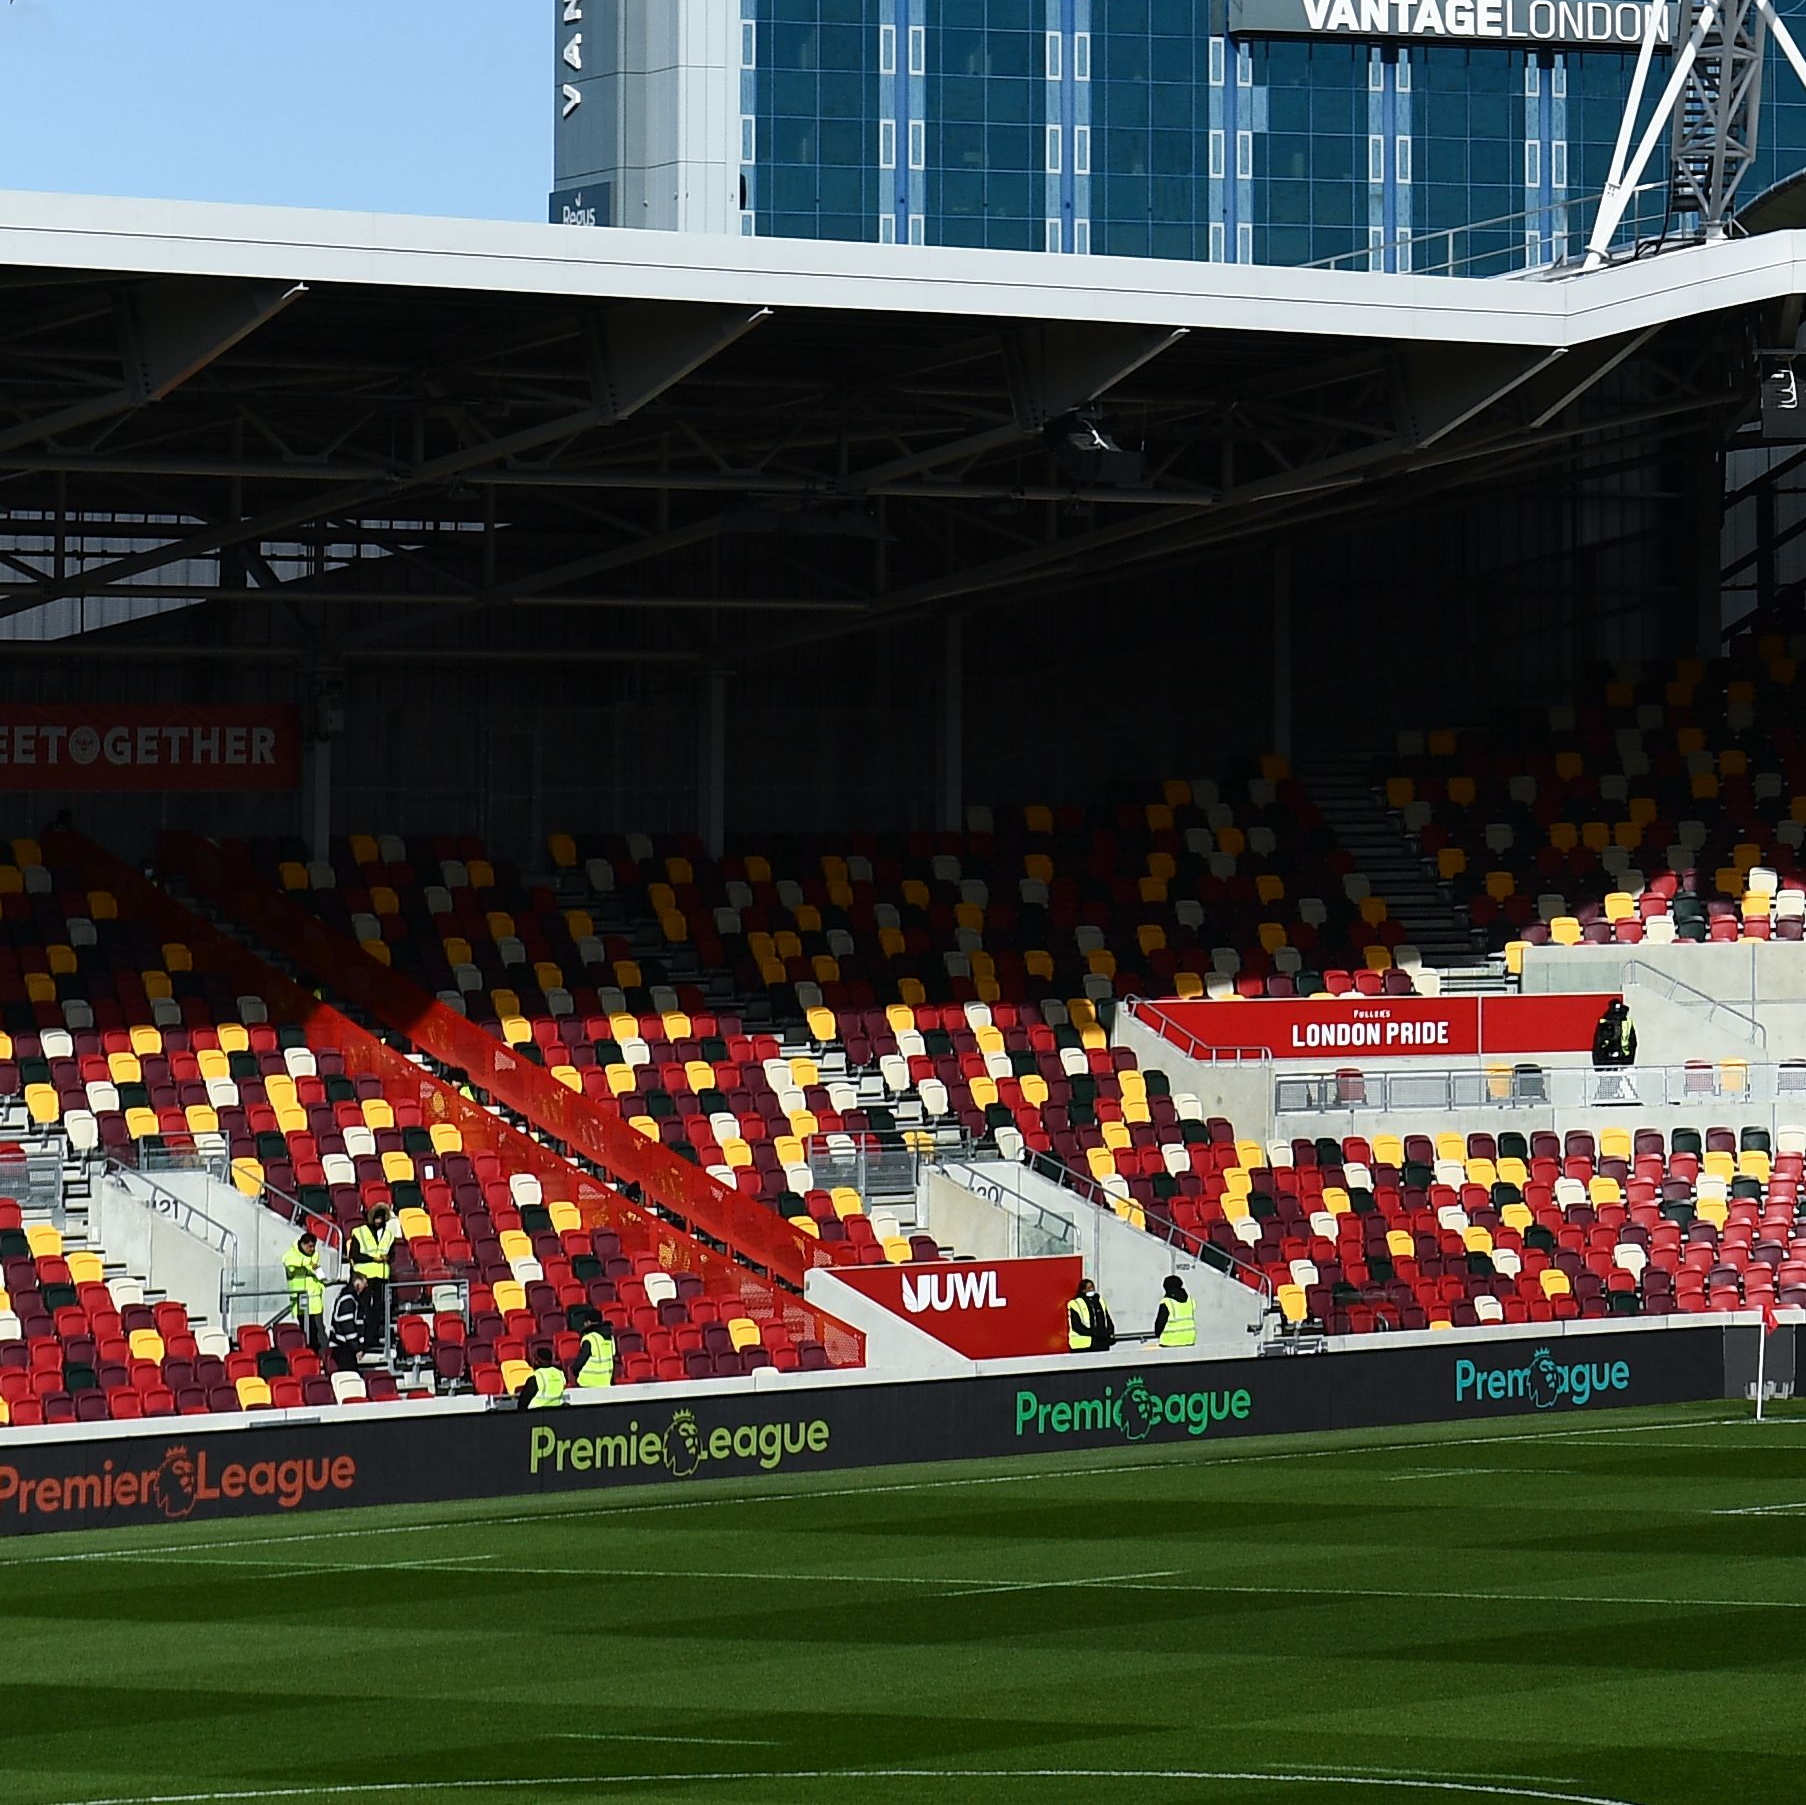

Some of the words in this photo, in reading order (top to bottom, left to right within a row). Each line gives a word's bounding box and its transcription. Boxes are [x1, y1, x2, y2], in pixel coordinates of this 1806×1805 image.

[1292, 1022, 1381, 1048] LONDON
[1386, 1021, 1449, 1046] PRIDE
[530, 1419, 665, 1475] Premie
[197, 1450, 356, 1508] League
